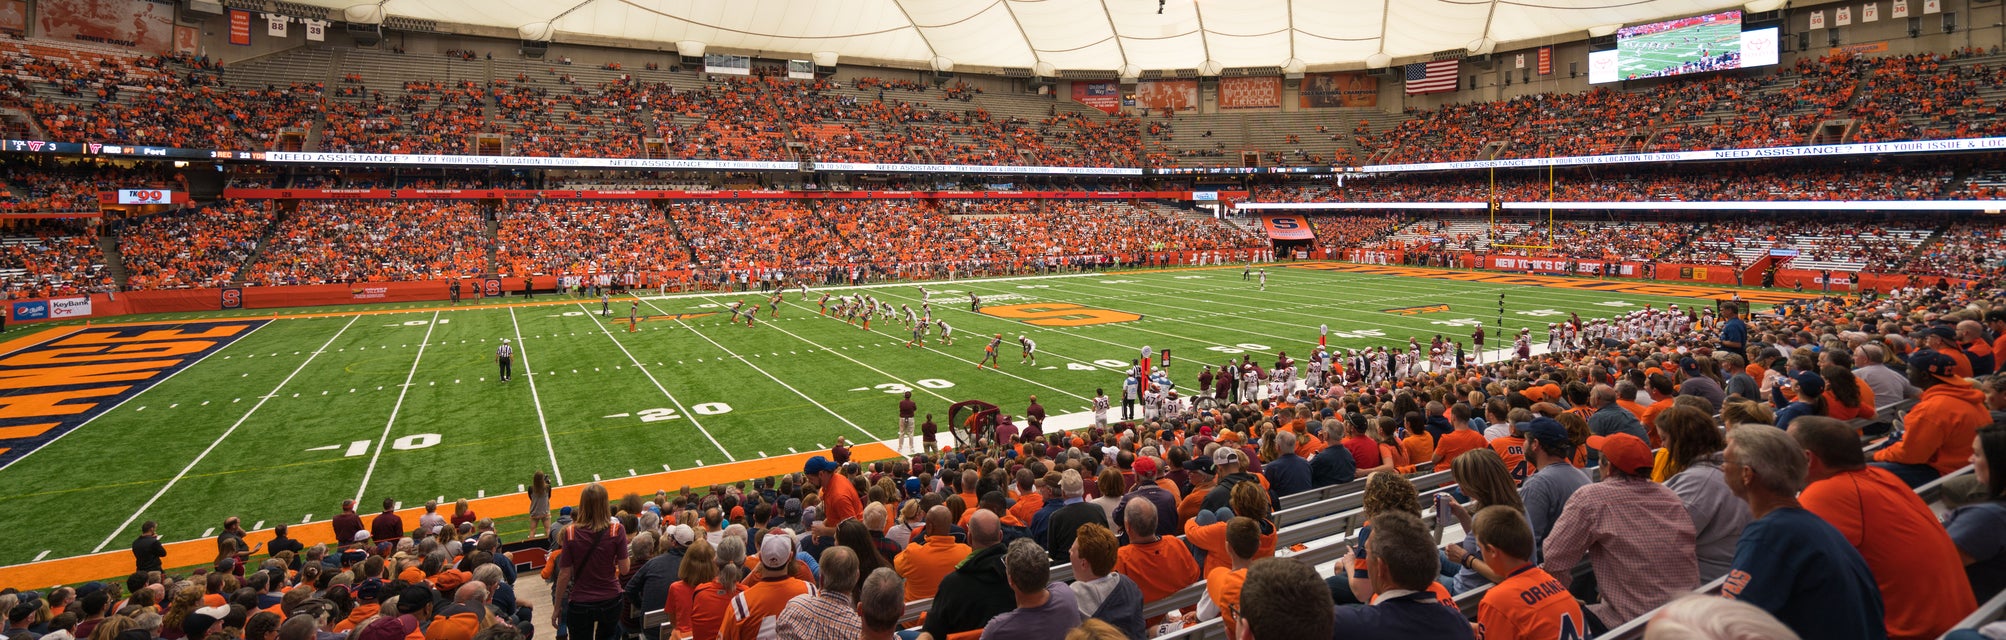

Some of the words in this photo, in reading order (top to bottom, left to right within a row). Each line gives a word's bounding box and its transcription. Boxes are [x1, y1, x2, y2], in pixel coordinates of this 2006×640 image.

[75, 34, 104, 43] ERNIE
[107, 38, 136, 47] DAVIS
[49, 143, 57, 151] 3
[1863, 144, 1888, 152] TEXT
[1892, 142, 1923, 151] YOUR
[1927, 141, 1962, 149] ISSUE
[144, 148, 166, 156] Ford
[1716, 150, 1750, 158] NEED
[1754, 146, 1852, 157] ASSISTANCE?
[274, 153, 312, 161] NEED
[317, 154, 408, 162] ASSISTANCE?
[1605, 155, 1641, 163] LOCATION
[1495, 258, 1515, 268] NEW
[53, 299, 89, 308] KeyBank
[874, 378, 956, 394] 30
[1099, 401, 1109, 409] 93
[1167, 404, 1177, 413] 91
[636, 402, 733, 422] 20
[1508, 445, 1524, 455] OR
